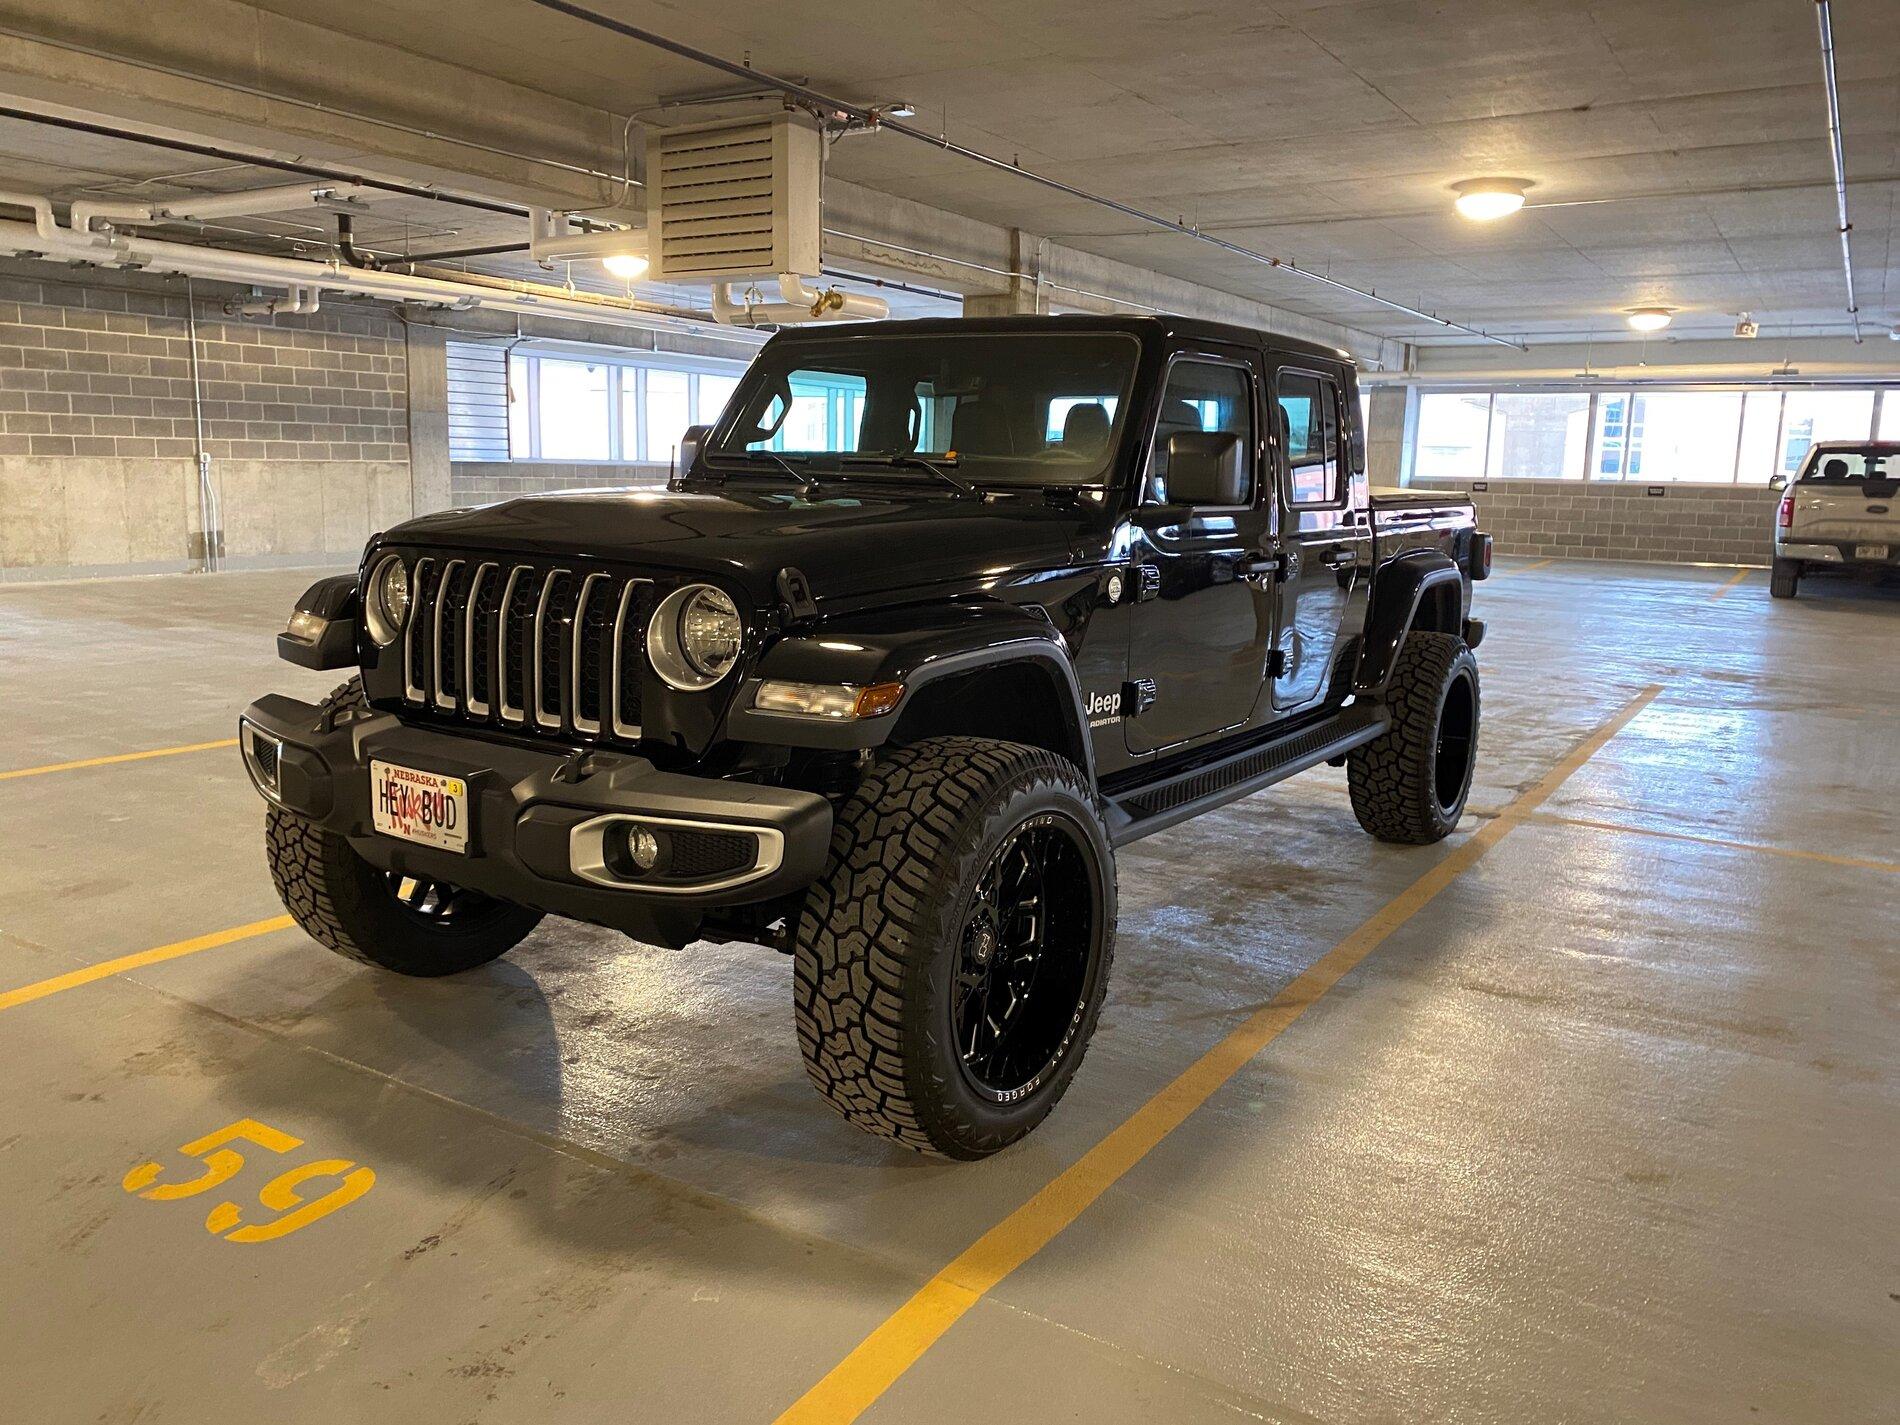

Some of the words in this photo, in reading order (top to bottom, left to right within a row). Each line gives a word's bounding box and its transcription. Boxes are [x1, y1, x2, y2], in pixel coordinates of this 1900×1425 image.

[1084, 691, 1121, 715] Jeep
[1089, 715, 1121, 728] ADIATOR
[393, 769, 438, 788] NEBRASKA
[379, 779, 408, 819] HEY
[422, 790, 456, 830] BUD
[997, 1076, 1041, 1102] FORGED
[121, 1117, 377, 1243] 59
